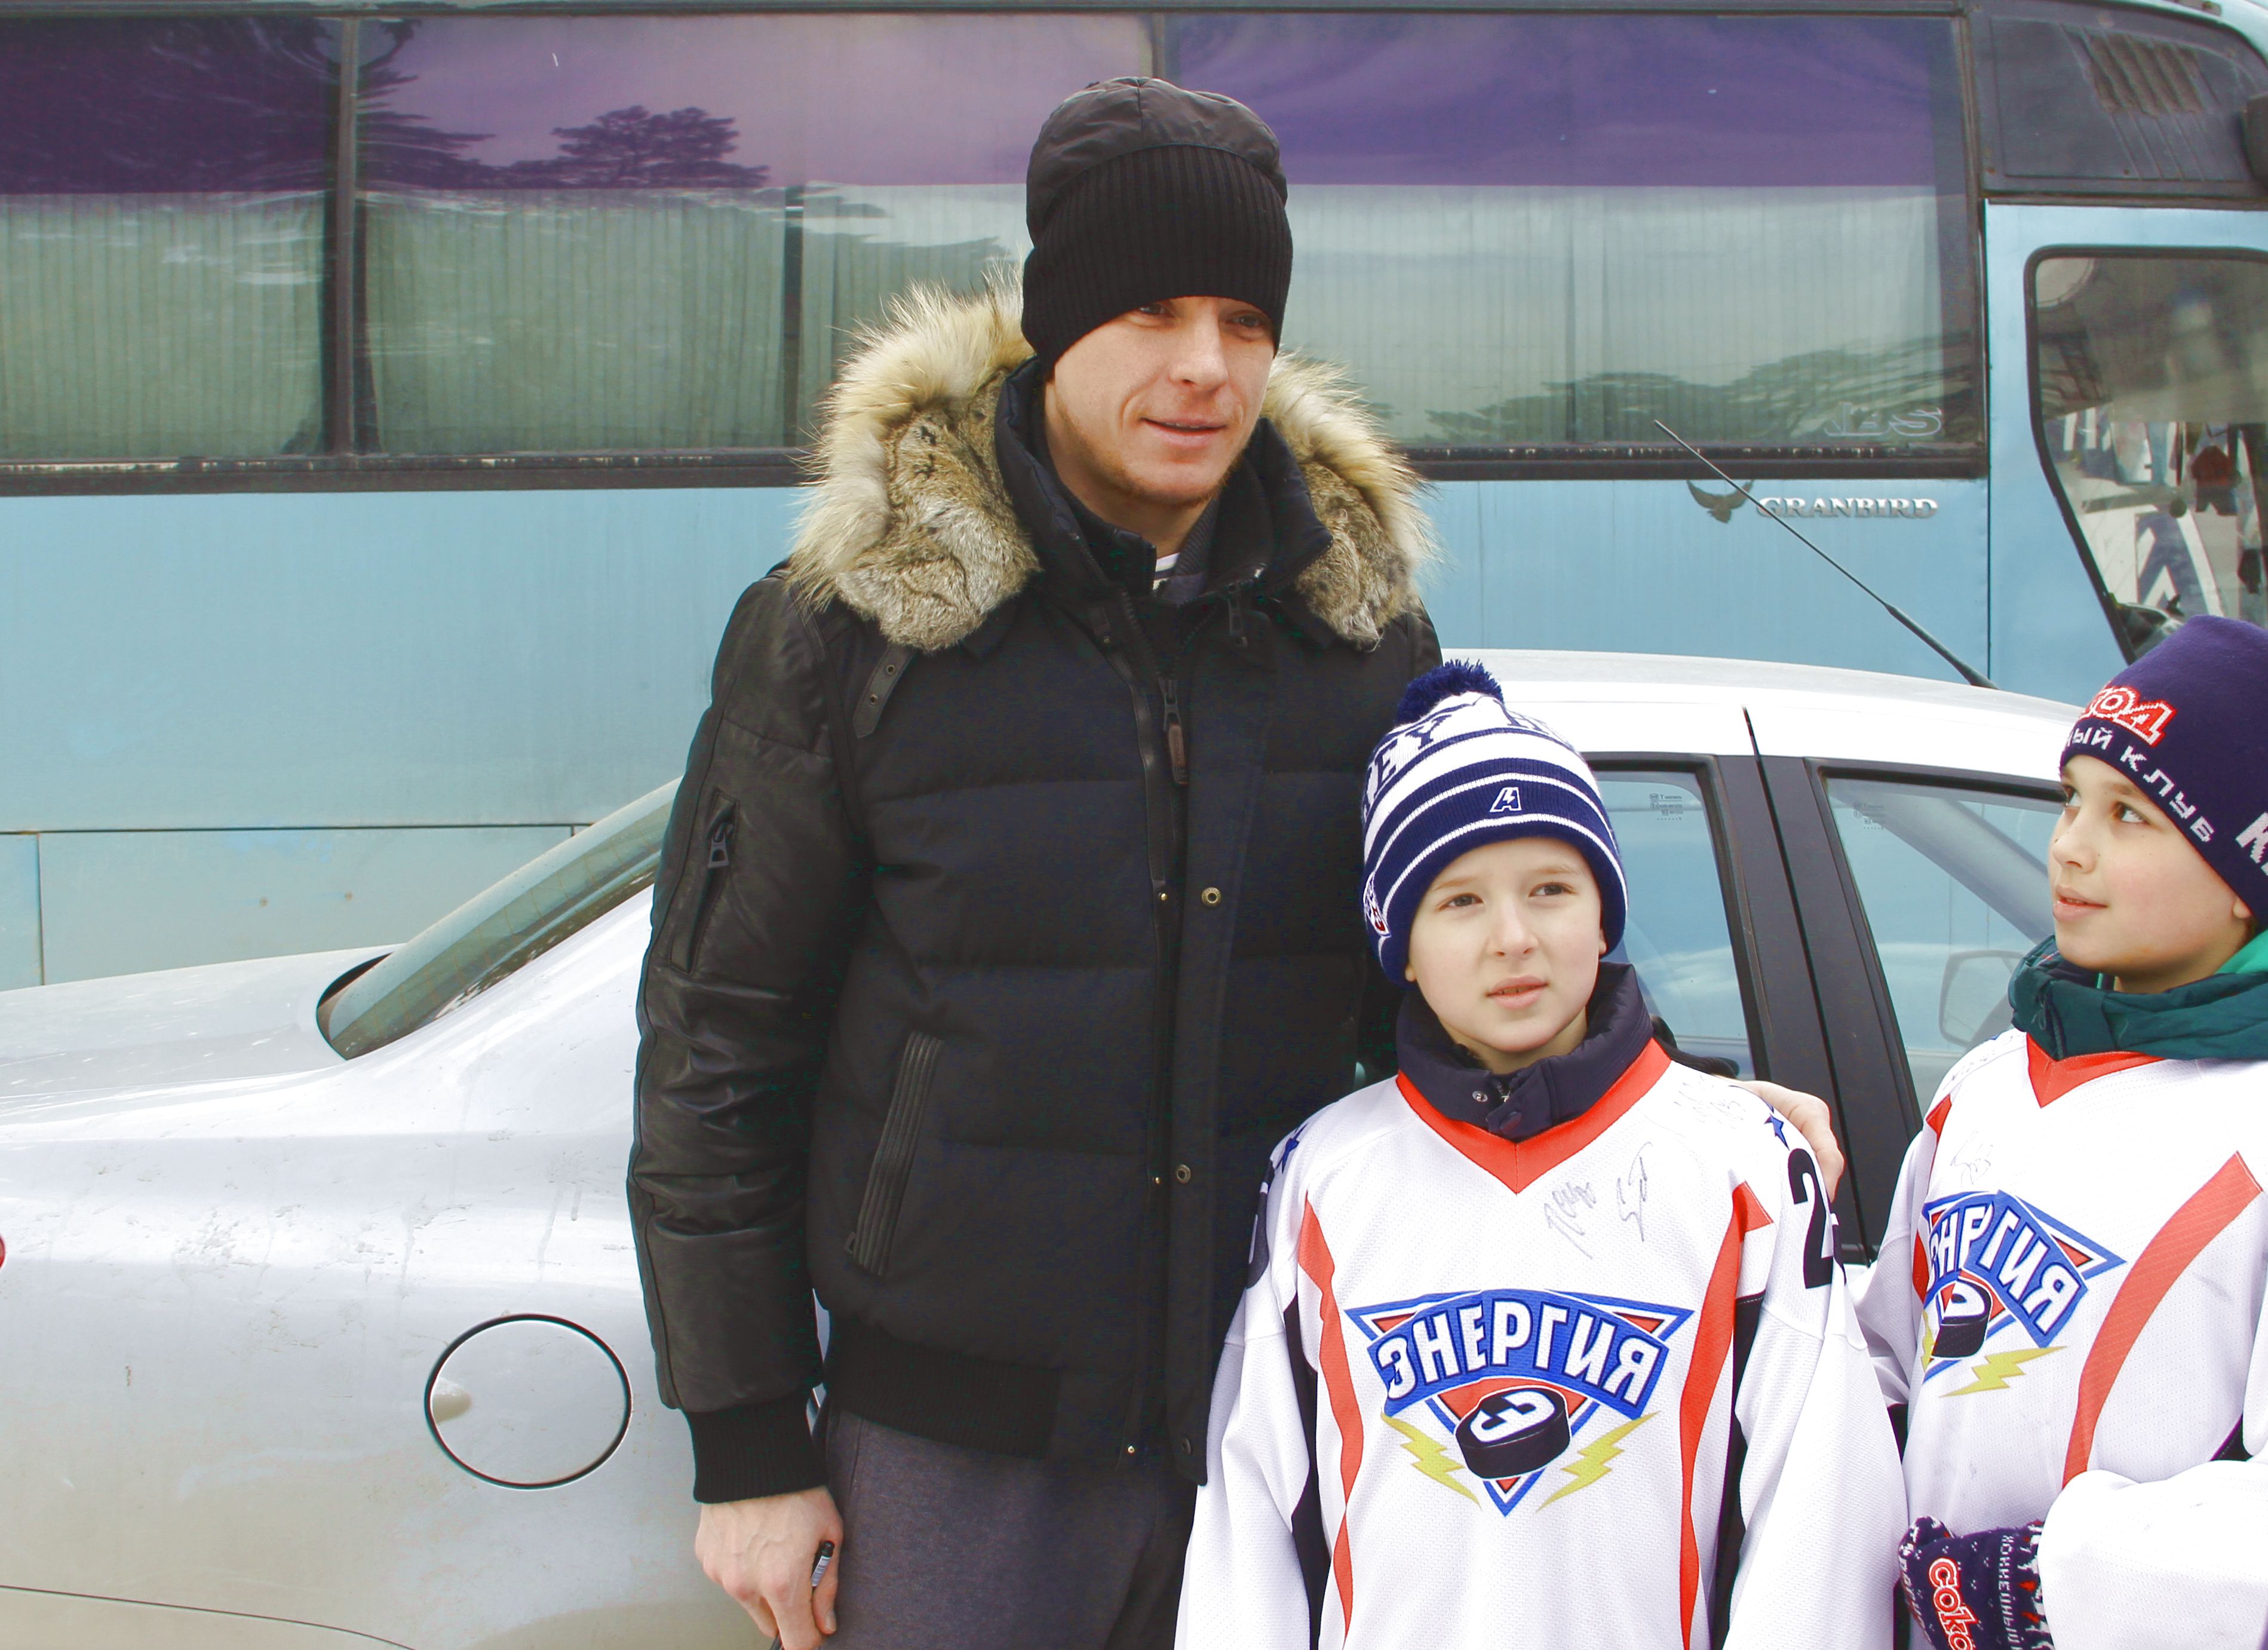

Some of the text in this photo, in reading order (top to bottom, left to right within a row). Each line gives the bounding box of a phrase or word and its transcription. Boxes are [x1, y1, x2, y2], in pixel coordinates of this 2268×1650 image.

[1757, 496, 1938, 519] GRANBIRD
[1788, 1148, 1846, 1289] 2
[1376, 1298, 1664, 1407] ЭНЕРГИЯ
